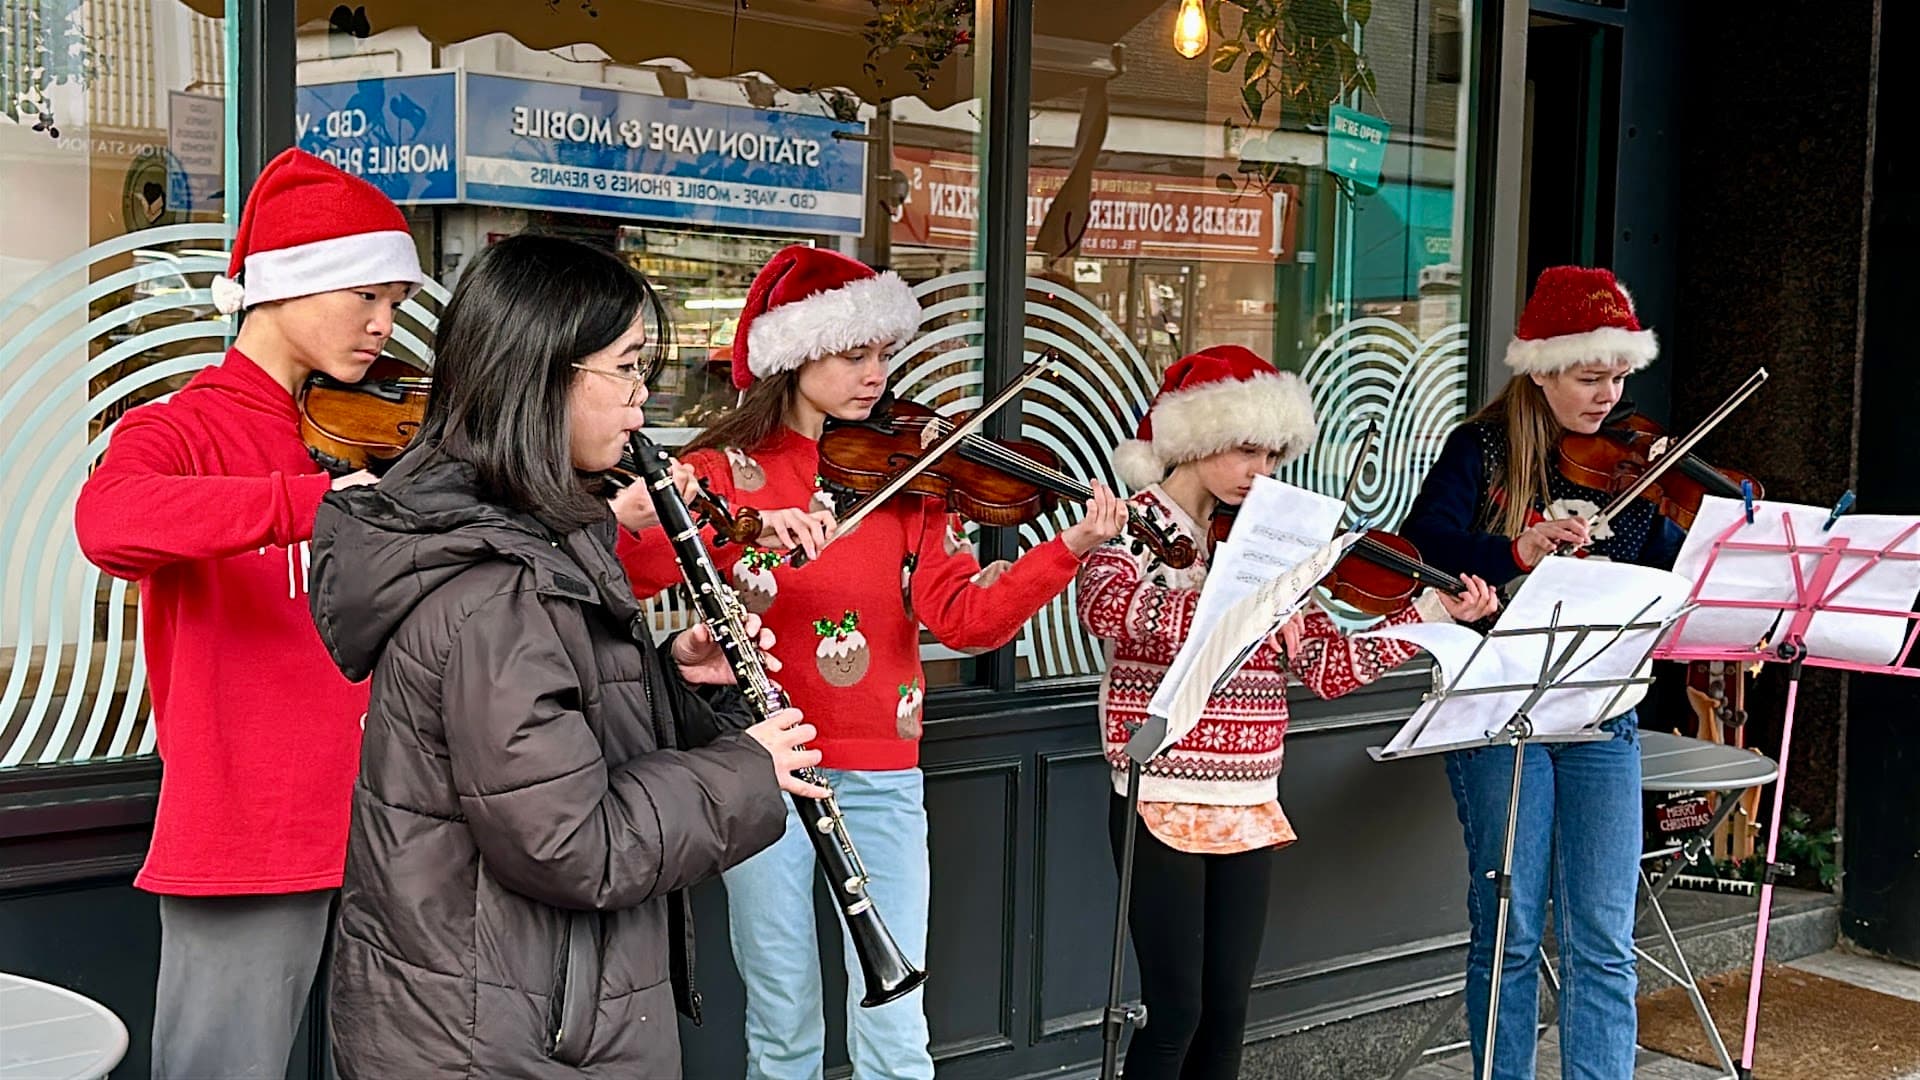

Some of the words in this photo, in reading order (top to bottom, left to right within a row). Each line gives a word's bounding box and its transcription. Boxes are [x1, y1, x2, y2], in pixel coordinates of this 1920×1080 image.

[1334, 115, 1358, 137] WE'RE
[1359, 124, 1383, 145] OPEN
[1666, 802, 1697, 818] MERRY
[1659, 813, 1710, 832] CHRISTMAS
